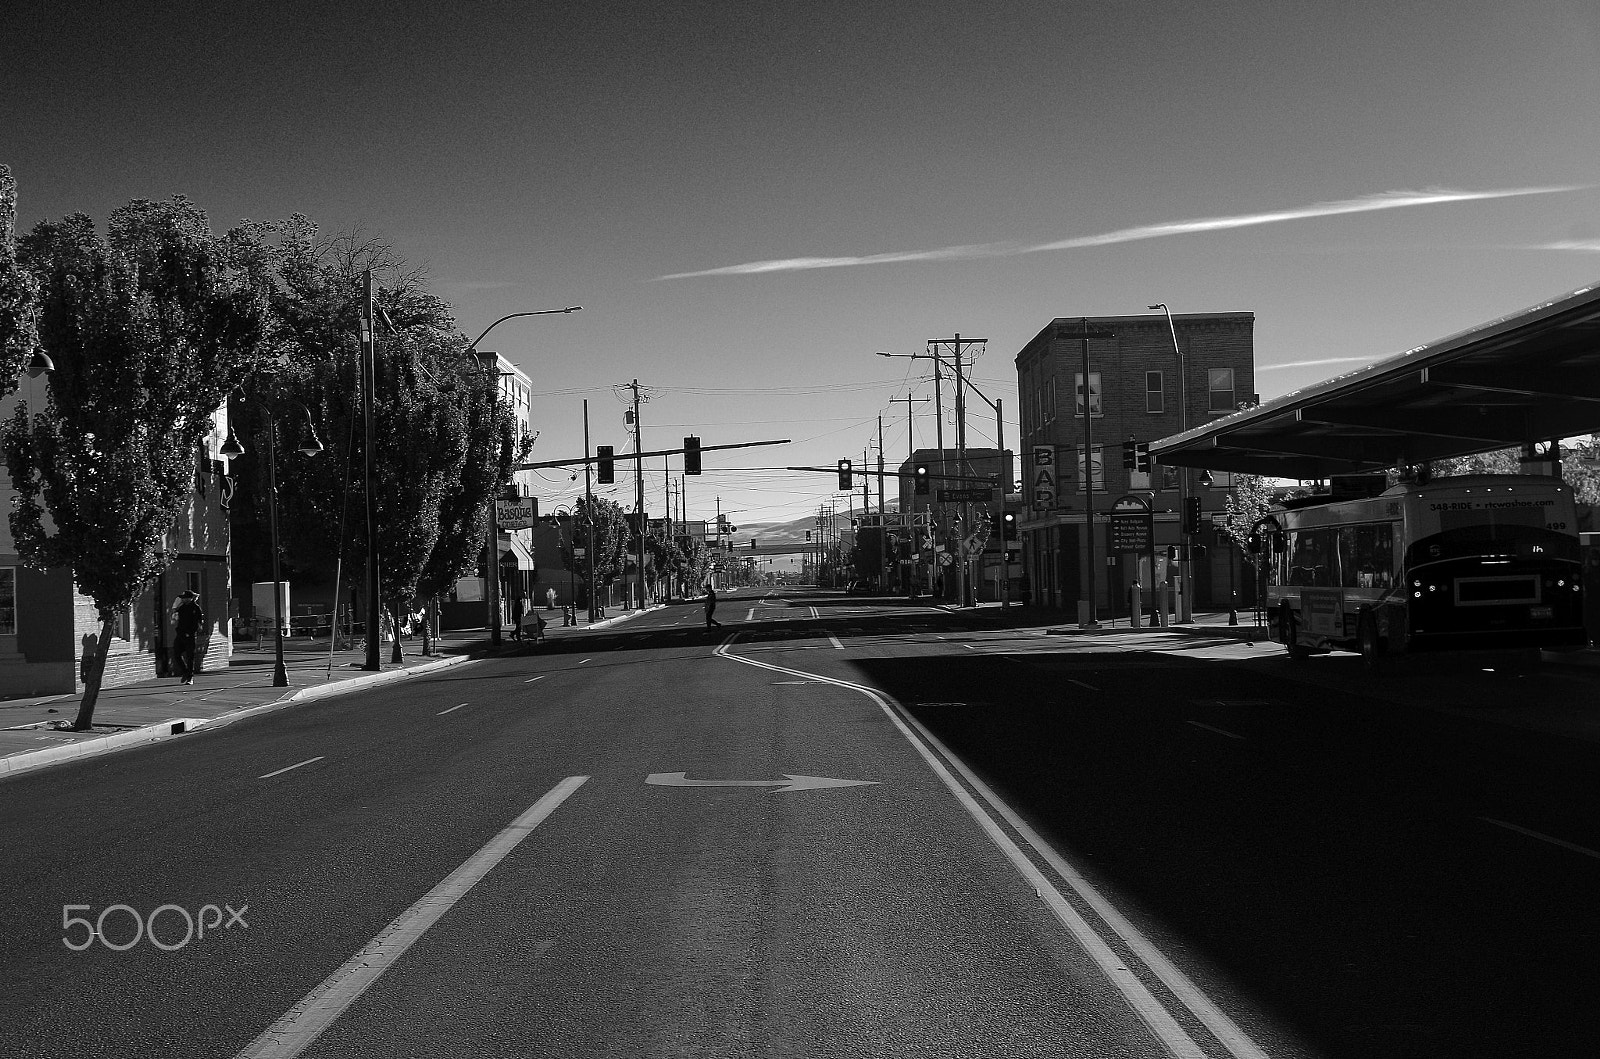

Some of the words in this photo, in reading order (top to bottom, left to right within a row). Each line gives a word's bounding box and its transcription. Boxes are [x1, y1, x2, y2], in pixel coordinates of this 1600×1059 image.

[1034, 448, 1055, 507] BAR
[1430, 502, 1471, 512] 348-RIDE
[1484, 499, 1554, 509] rtcwashoe.com
[1546, 522, 1566, 530] 499
